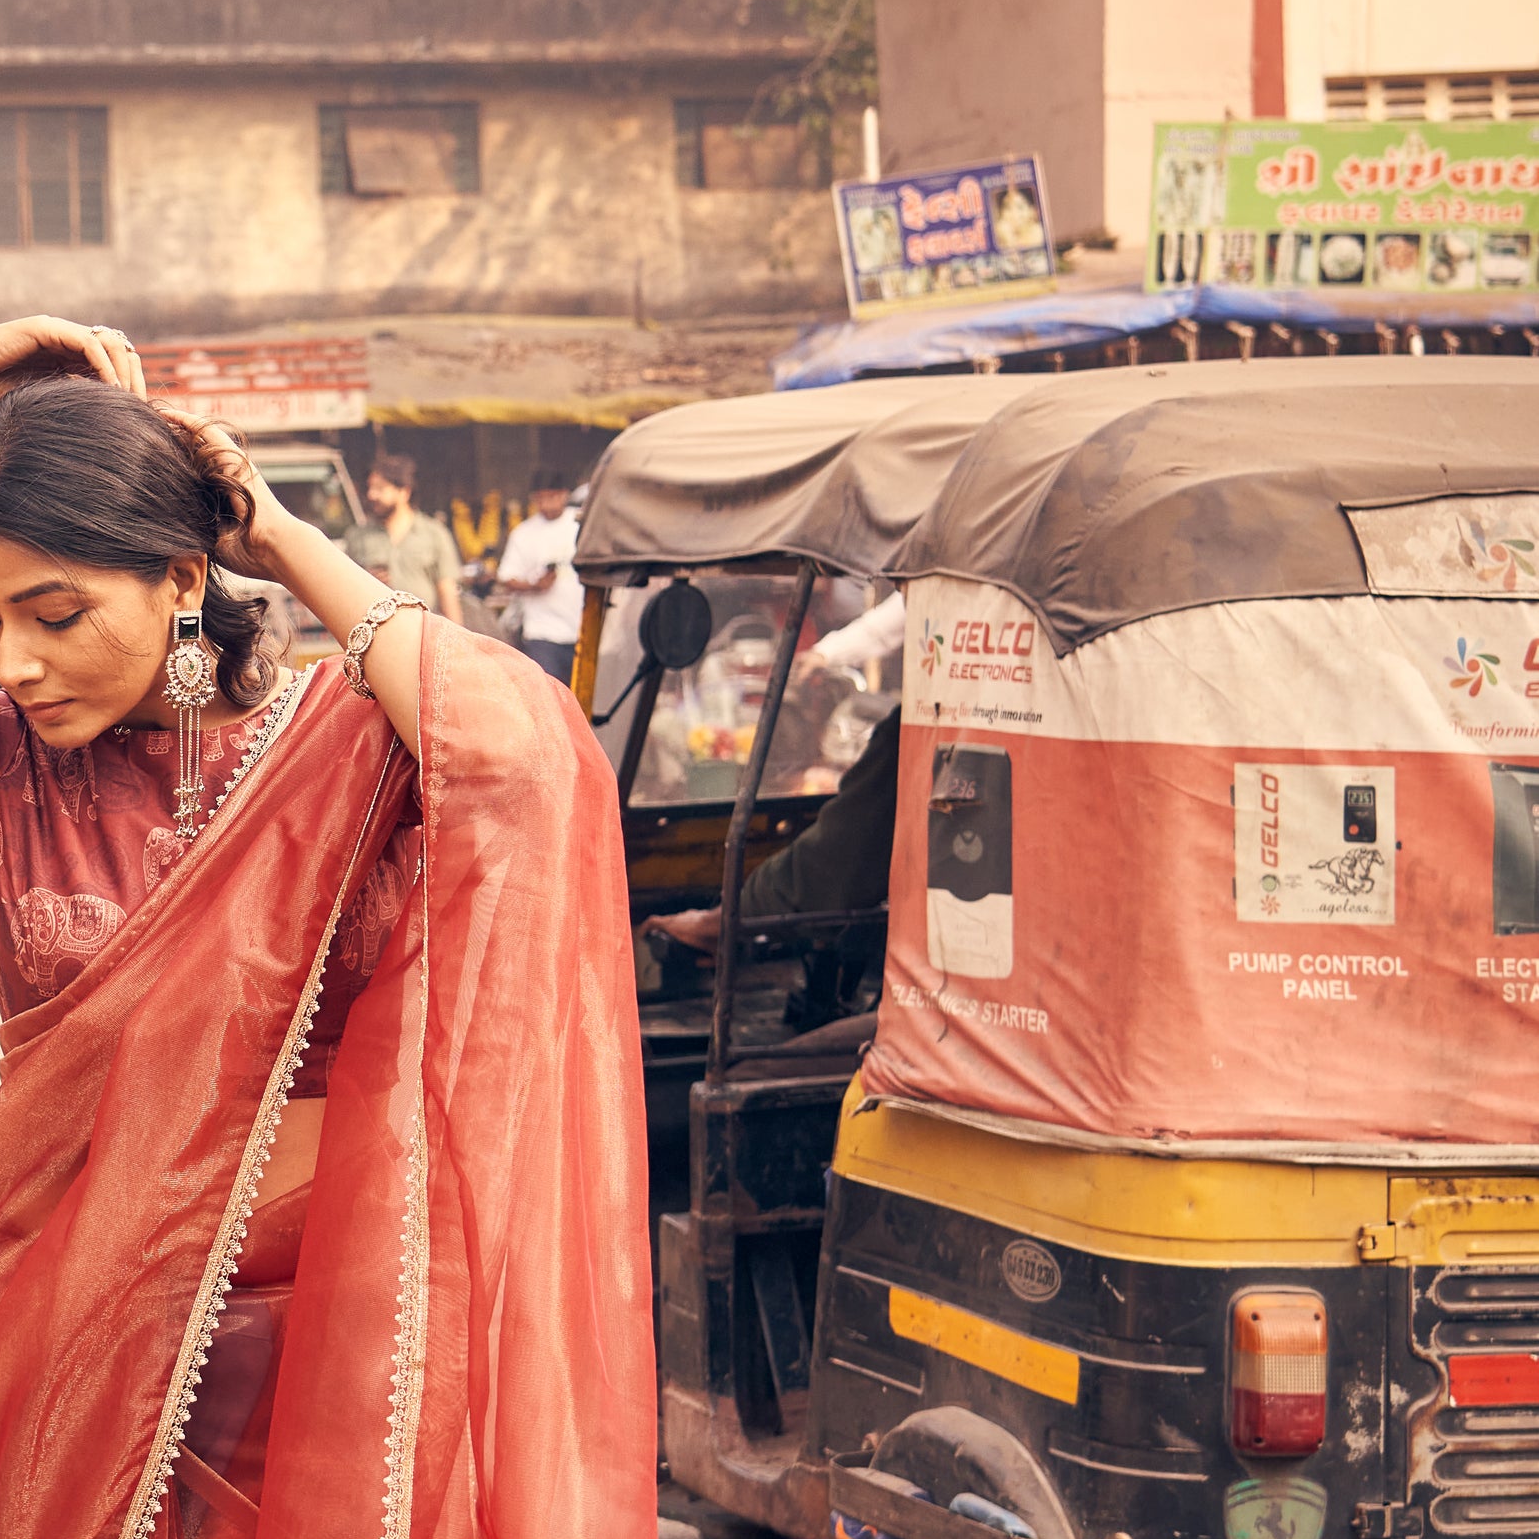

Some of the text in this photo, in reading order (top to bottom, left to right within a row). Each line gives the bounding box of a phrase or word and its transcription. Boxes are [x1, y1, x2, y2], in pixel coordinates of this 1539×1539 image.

[951, 621, 1035, 657] GELCO
[948, 662, 1033, 685] ELECTRONICS
[1261, 772, 1279, 869] GELCO
[1228, 952, 1409, 977] PUMP CONTROL
[1282, 979, 1358, 1001] PANEL
[981, 1001, 1049, 1034] STARTER
